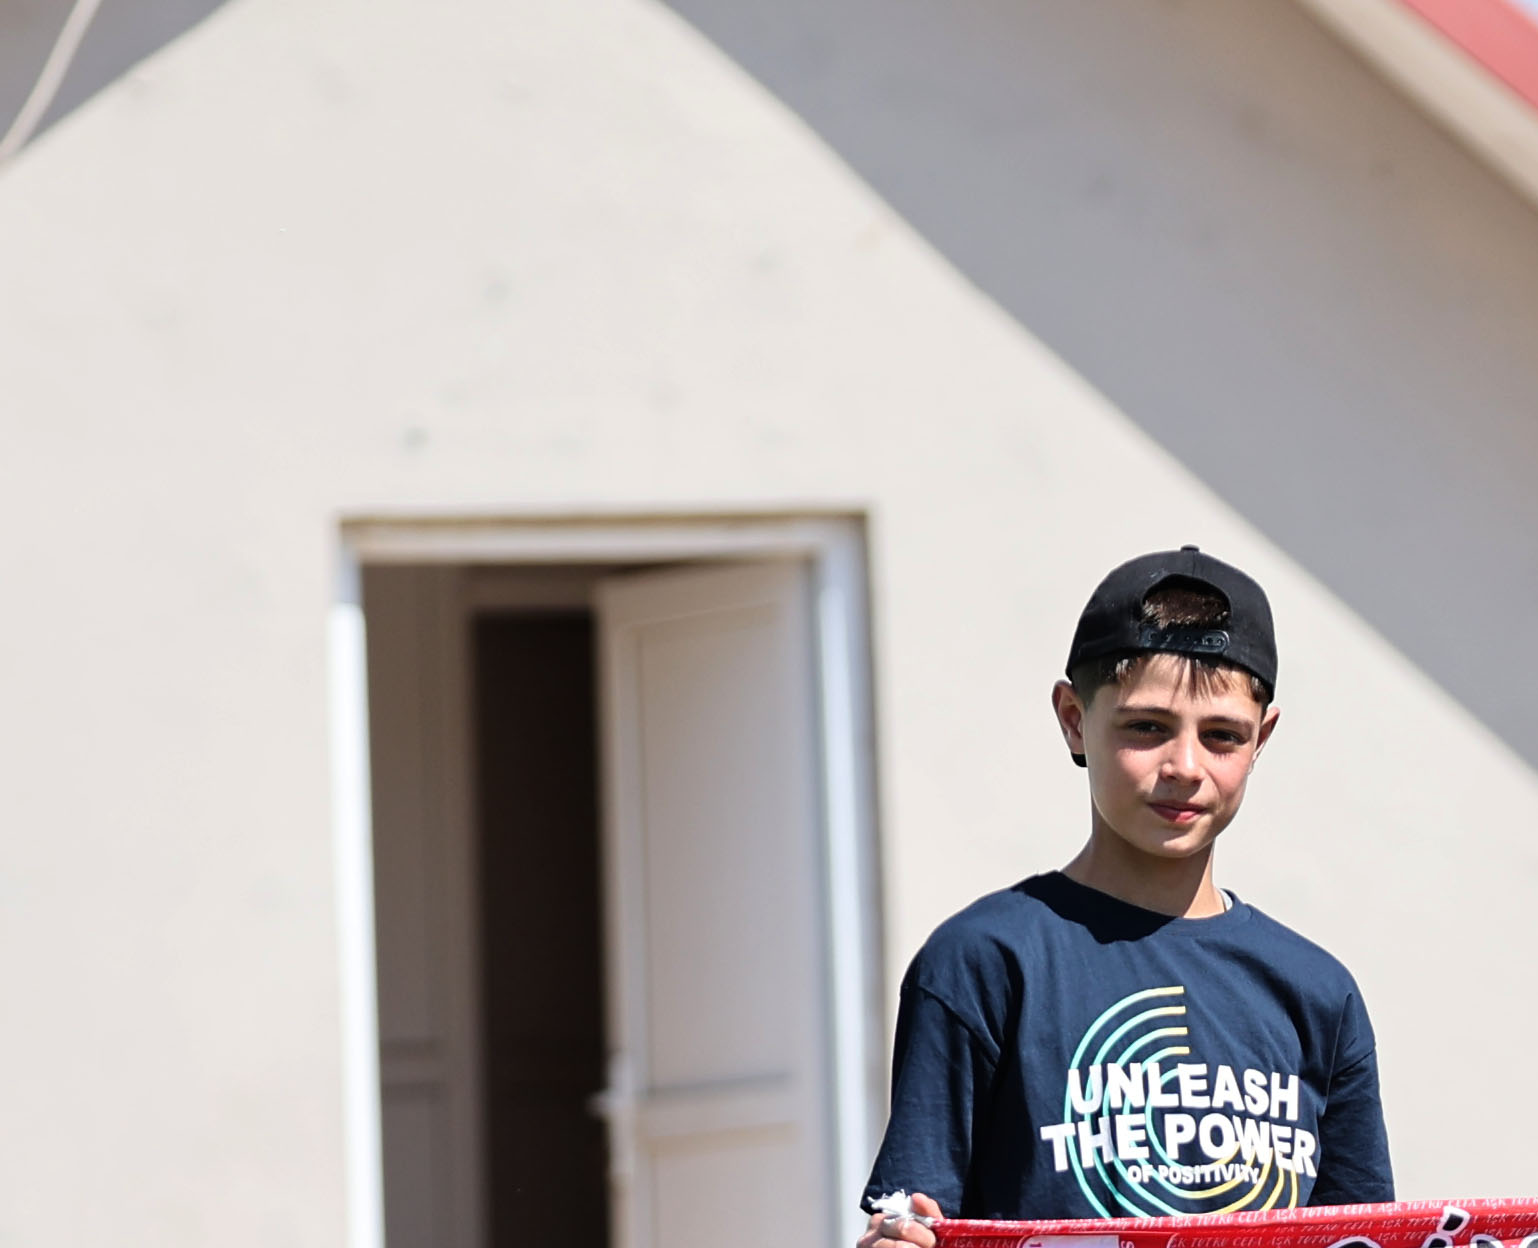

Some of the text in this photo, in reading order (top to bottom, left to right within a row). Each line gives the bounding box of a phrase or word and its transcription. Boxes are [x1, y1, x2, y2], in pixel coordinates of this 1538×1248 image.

[1067, 1062, 1299, 1121] UNLEASH
[1040, 1113, 1318, 1178] THE POWER
[1128, 1164, 1260, 1185] OF POSITIVITY
